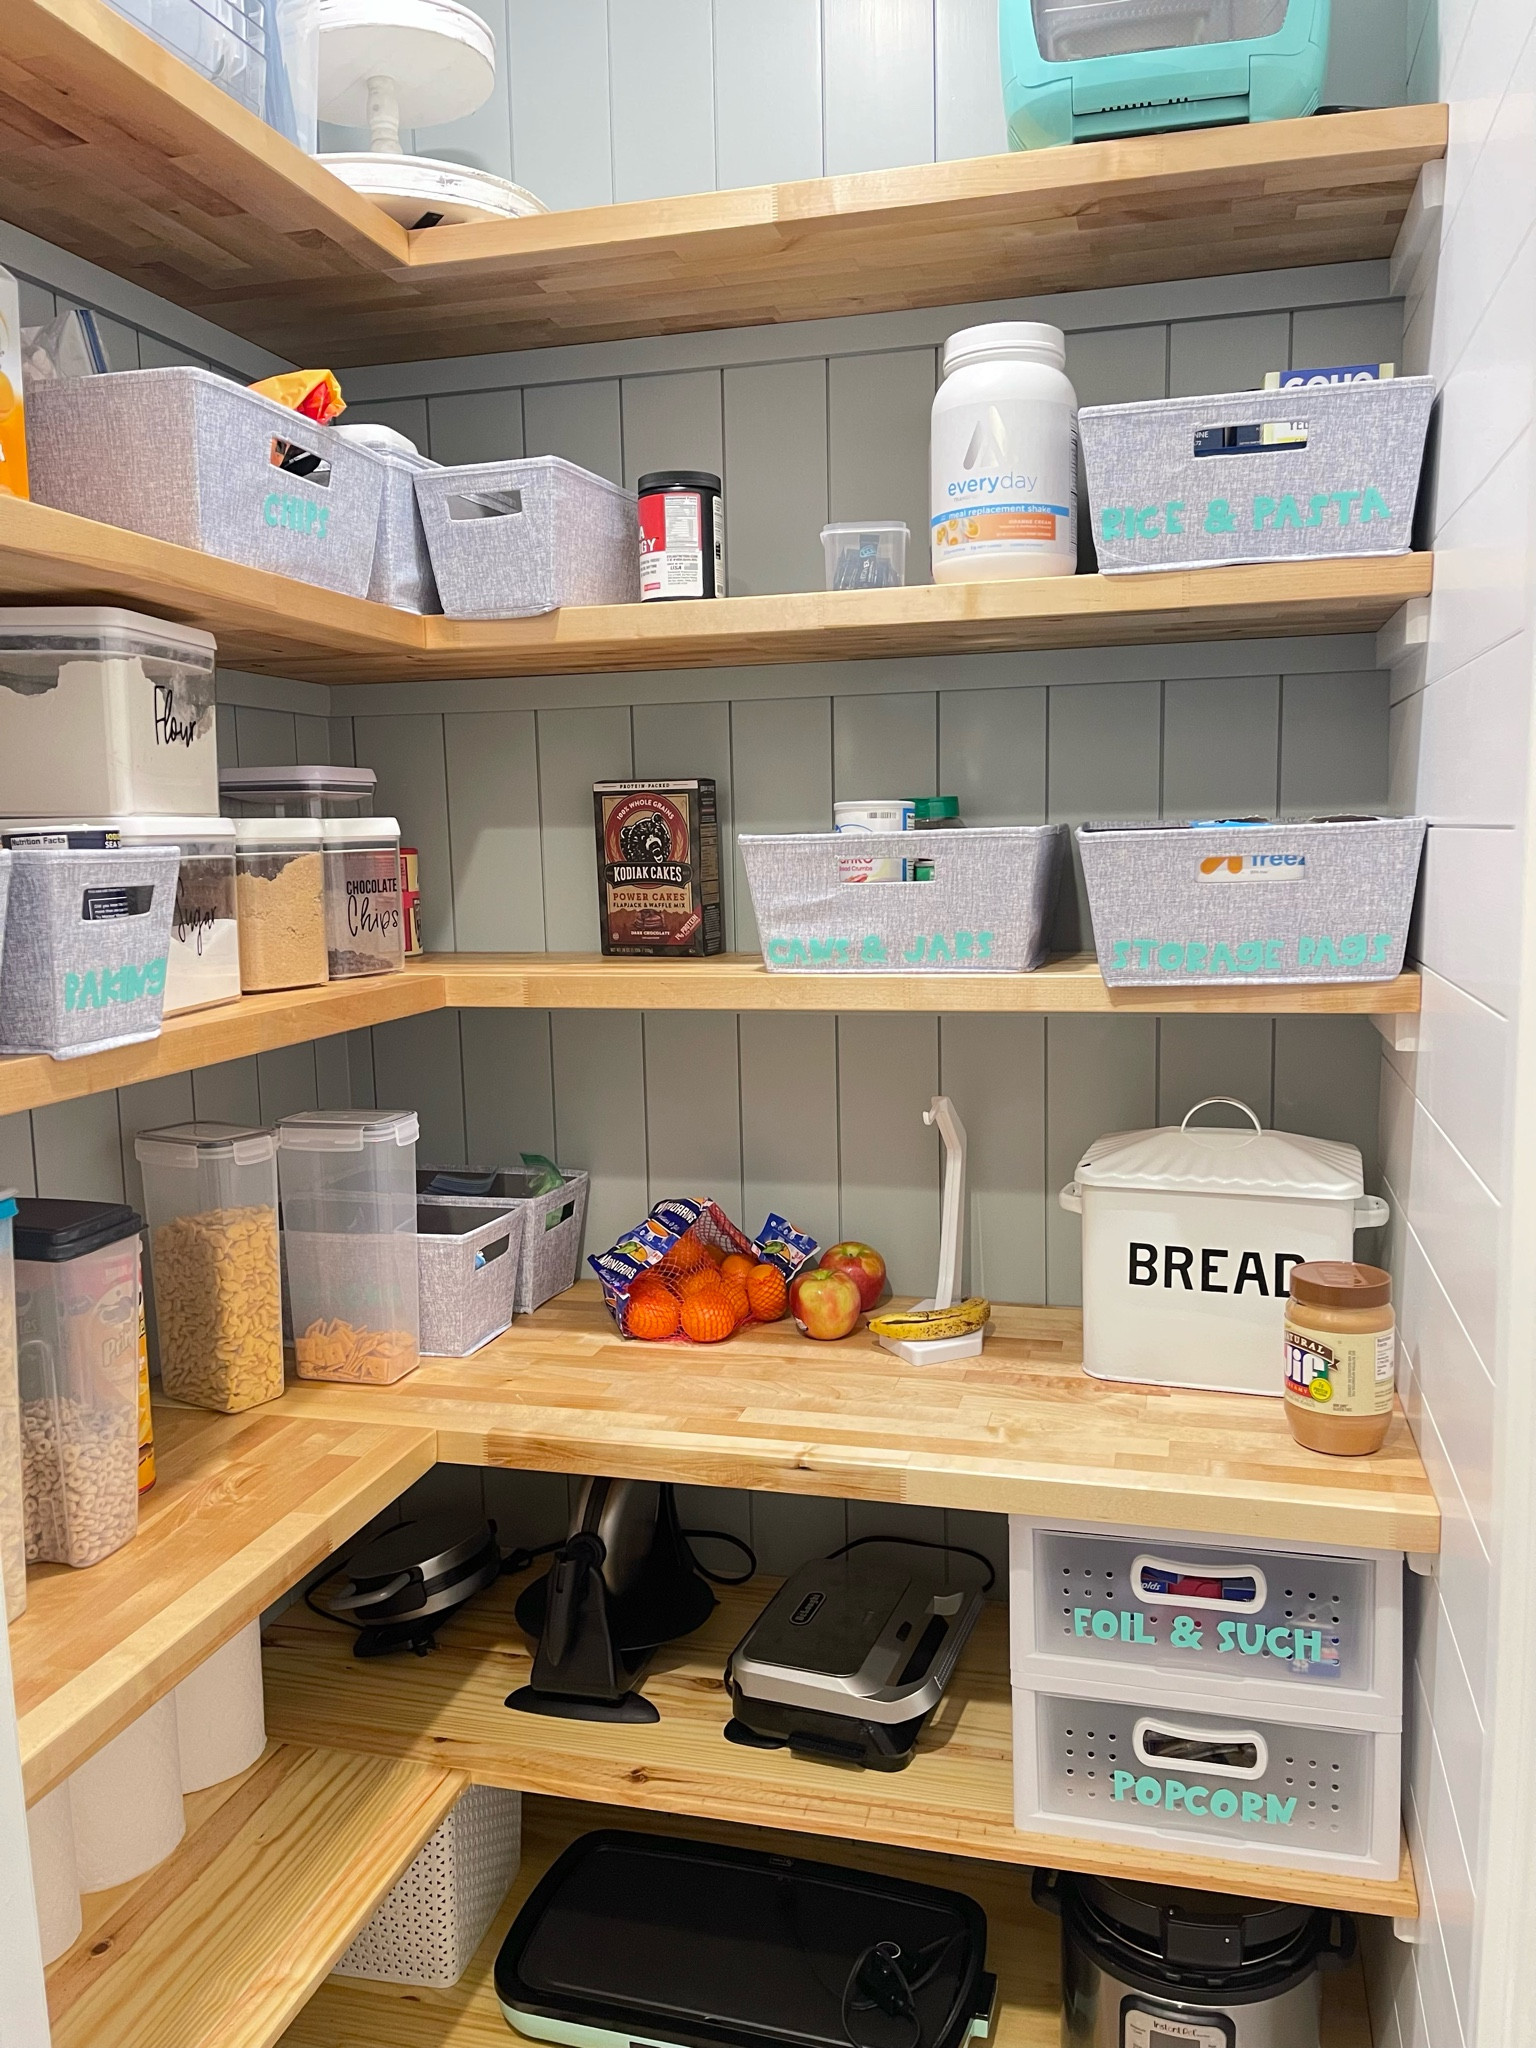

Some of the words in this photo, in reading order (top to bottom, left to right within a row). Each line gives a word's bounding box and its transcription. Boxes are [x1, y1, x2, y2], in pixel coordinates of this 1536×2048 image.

[948, 471, 1038, 497] everyday
[263, 492, 330, 539] CHIPS
[948, 511, 967, 520] meal
[968, 504, 1026, 517] replacement
[1027, 503, 1052, 513] shake
[1101, 500, 1185, 542] RICE
[1203, 498, 1238, 535] &
[1252, 486, 1391, 531] PASTA
[154, 685, 197, 748] Flour
[616, 805, 630, 820] 100%
[629, 799, 652, 809] WHOLE
[653, 801, 675, 820] GRAINS
[11, 837, 41, 846] Nutrition
[43, 836, 66, 844] Facts
[346, 878, 398, 895] CHOCOLATE
[613, 866, 649, 882] KODIAK
[650, 866, 682, 882] CAKES
[175, 876, 217, 956] Sugar
[347, 894, 399, 938] Chips
[613, 893, 649, 901] POWER
[652, 893, 686, 901] CAKES
[767, 937, 850, 965] CANS
[861, 933, 889, 963] &
[902, 930, 994, 963] JARS
[1111, 939, 1285, 973] STORAGE
[1300, 933, 1393, 967] BAGS
[65, 957, 167, 1013] BAKING
[1128, 1241, 1306, 1299] BREAD
[1285, 1343, 1325, 1386] Jif
[1141, 1580, 1161, 1592] olds
[1074, 1607, 1156, 1645] FOIL
[1170, 1615, 1204, 1650] &
[1217, 1620, 1322, 1663] SUCH
[1113, 1769, 1298, 1825] POPCORN
